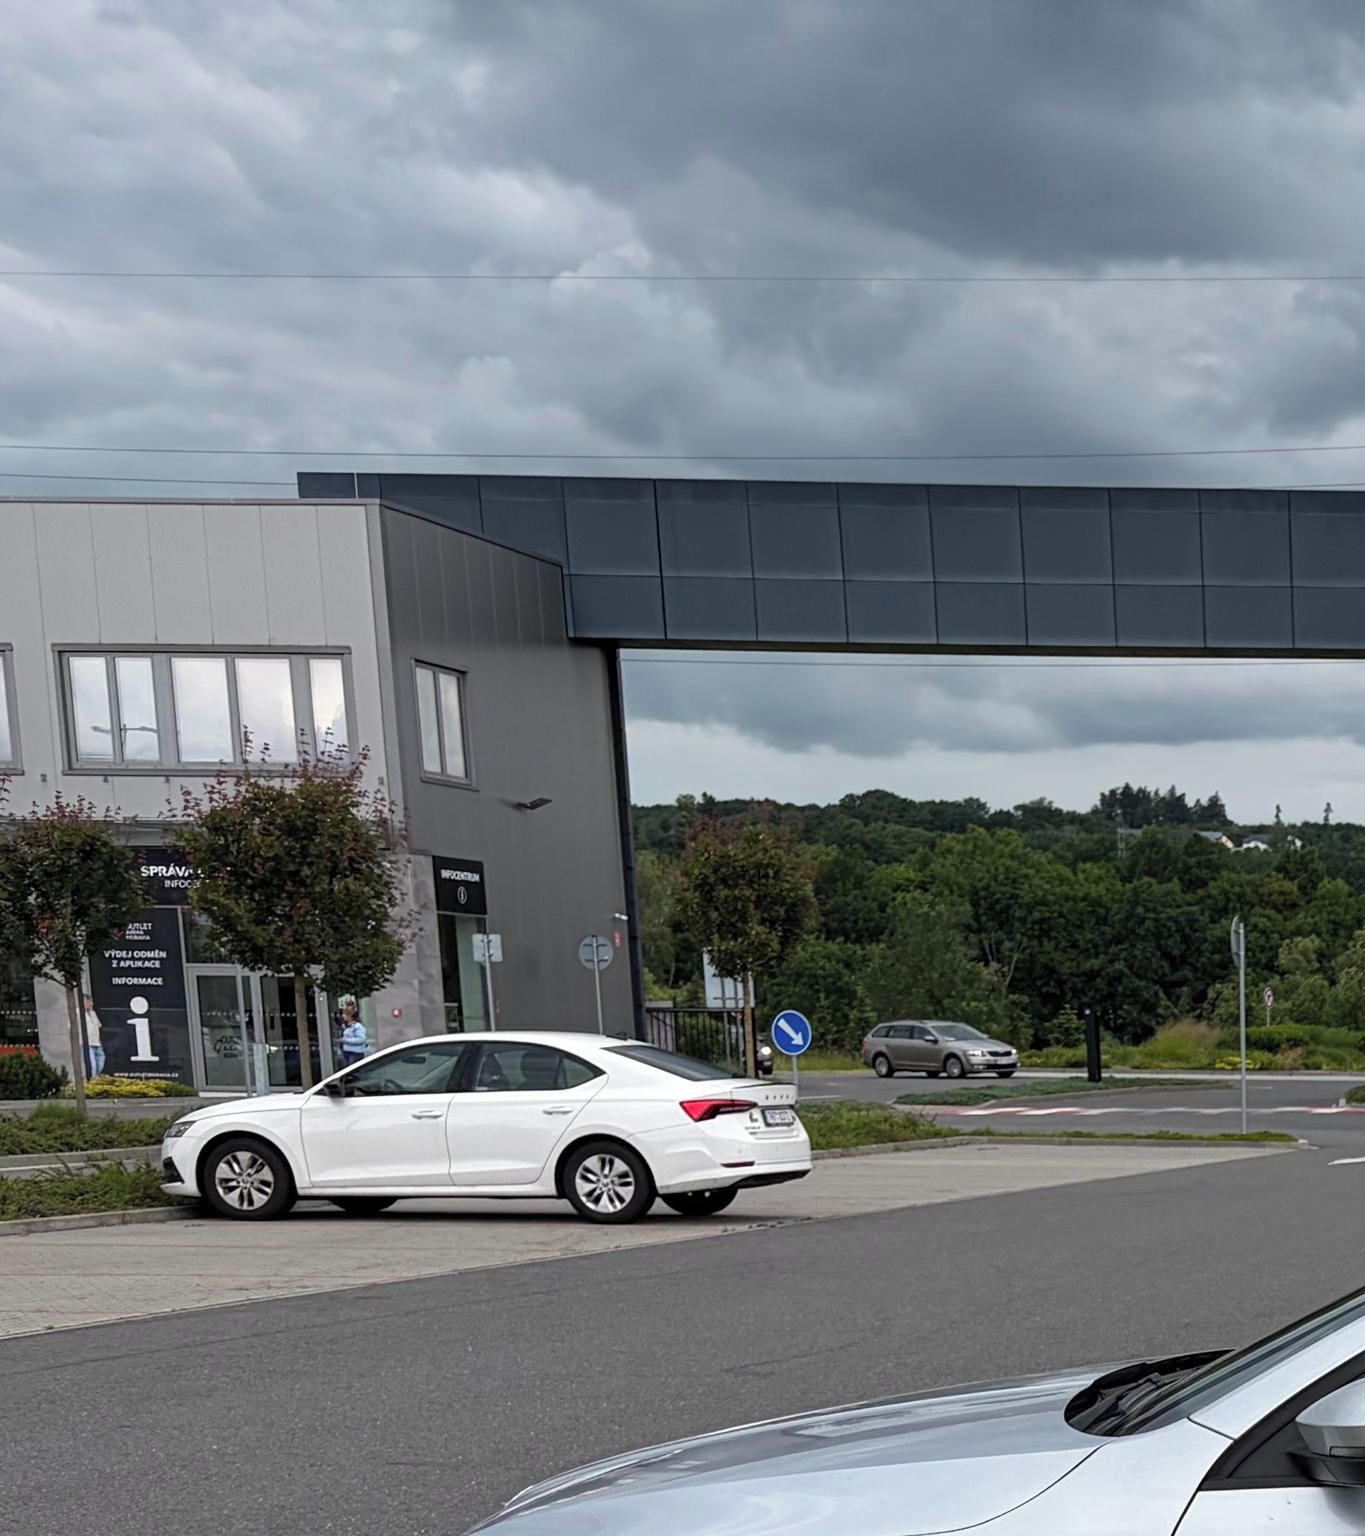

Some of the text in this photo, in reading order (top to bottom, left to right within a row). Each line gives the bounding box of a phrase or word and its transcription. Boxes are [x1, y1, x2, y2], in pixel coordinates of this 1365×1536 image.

[104, 948, 167, 959] VÝDEJ ODMĚN
[112, 960, 161, 968] Z APLIKACE
[112, 977, 163, 985] INFORMACE
